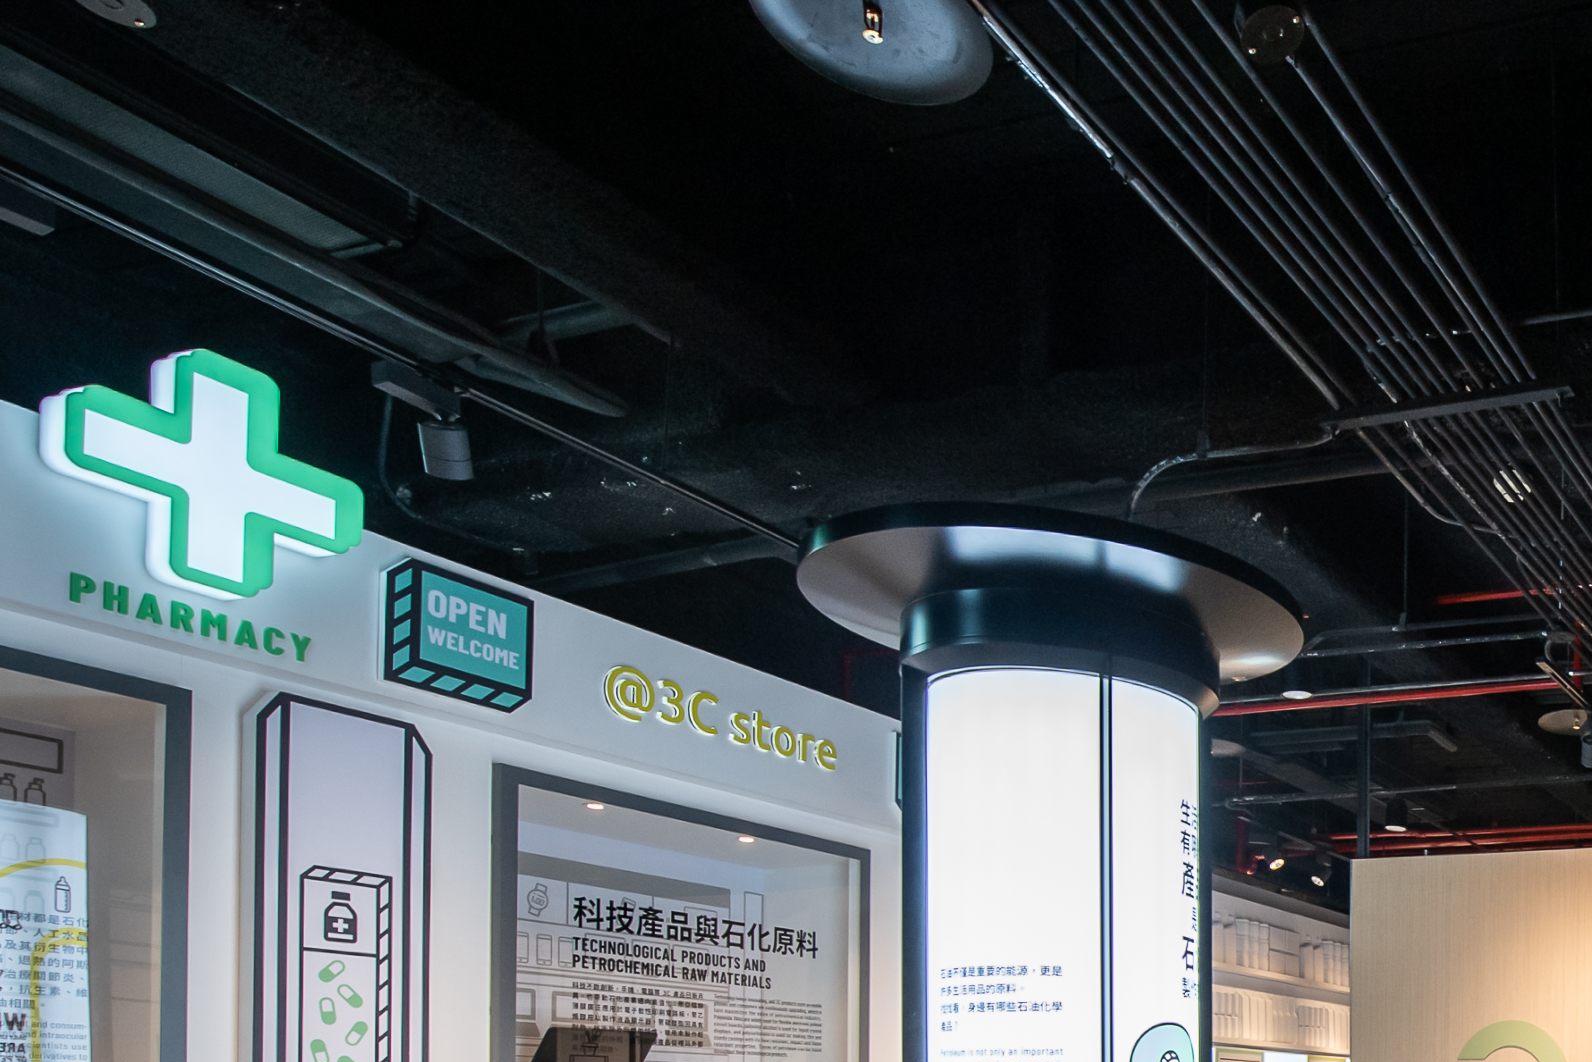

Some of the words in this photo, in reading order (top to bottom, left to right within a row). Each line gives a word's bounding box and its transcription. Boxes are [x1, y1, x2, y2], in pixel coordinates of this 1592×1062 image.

[69, 572, 312, 662] PHARMACY
[427, 589, 507, 640] OPEN
[427, 626, 520, 670] WELCOME
[604, 665, 719, 736] @3C
[729, 711, 838, 770] store
[573, 896, 819, 960] 科技產品與石化原料
[572, 954, 678, 979] PETROCHEMICAL
[682, 966, 708, 982] RAW
[711, 971, 772, 990] MATERIALS
[573, 937, 678, 962] TECHNOLOGICAL
[681, 950, 741, 969] PRODUCTS
[744, 958, 766, 973] AND
[71, 1043, 87, 1051] use
[79, 1053, 88, 1061] to
[1020, 1047, 1064, 1056] important
